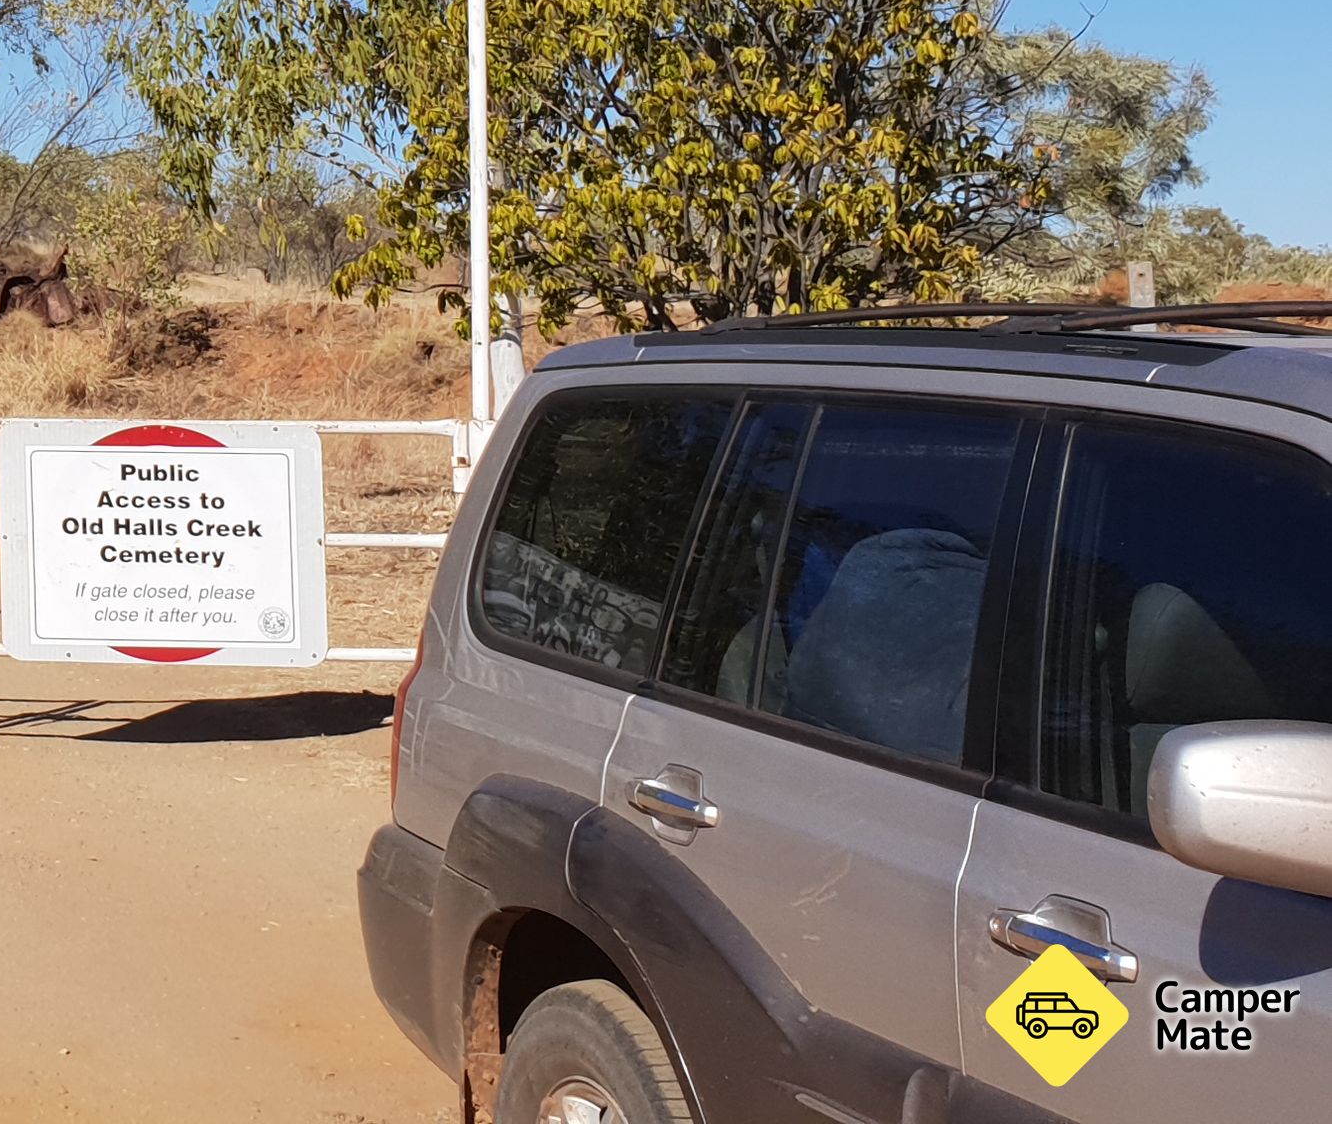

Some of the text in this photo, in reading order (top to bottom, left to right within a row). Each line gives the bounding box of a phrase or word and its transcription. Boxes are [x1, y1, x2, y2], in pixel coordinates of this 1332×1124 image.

[120, 463, 200, 482] Public
[97, 490, 225, 510] Access to
[61, 517, 263, 537] Old Halls Creek
[99, 545, 225, 568] Cemetery
[75, 582, 255, 603] If gate closed, please
[94, 607, 139, 623] close
[144, 607, 154, 622] it
[159, 607, 198, 623] after
[202, 611, 238, 627] you.
